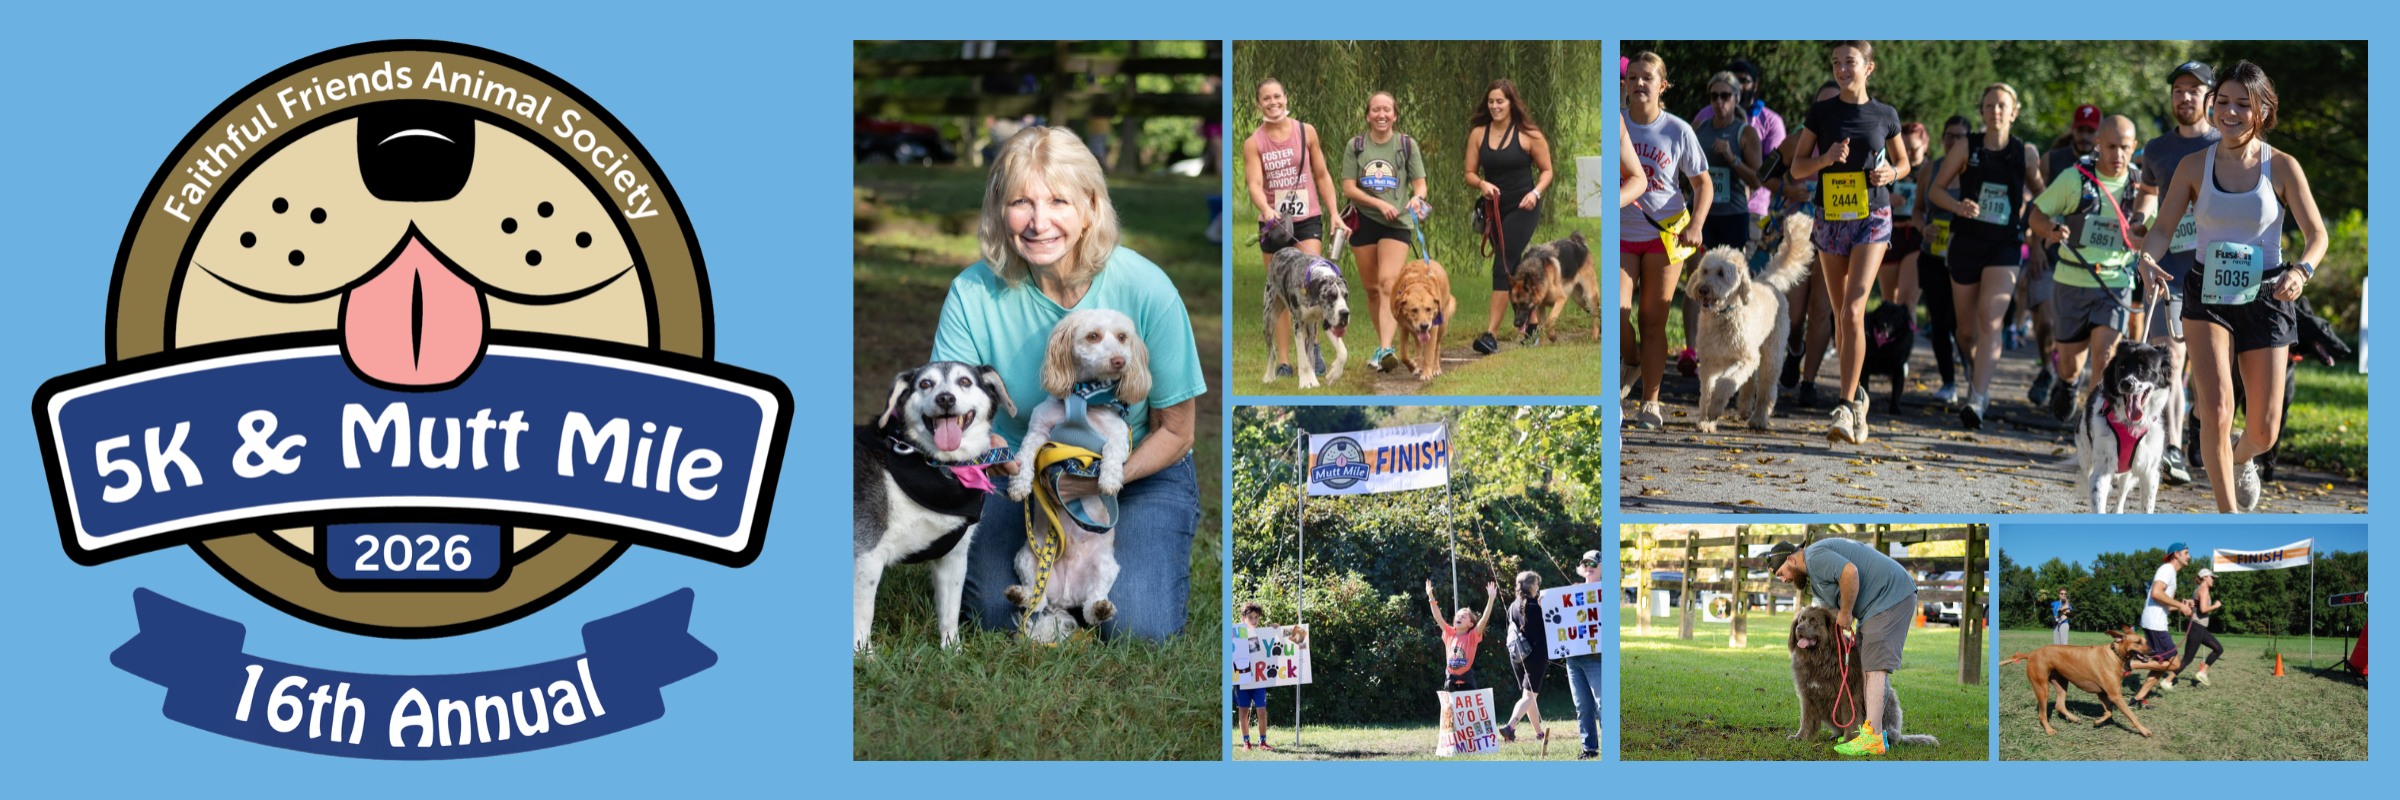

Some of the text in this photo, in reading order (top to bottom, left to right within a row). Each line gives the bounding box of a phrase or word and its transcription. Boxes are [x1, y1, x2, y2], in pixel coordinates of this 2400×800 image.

[164, 61, 658, 223] Faithful Friends Animal Society
[1262, 148, 1294, 162] FOSTER
[1264, 158, 1291, 171] ADOPT
[1266, 166, 1297, 179] RESCUE
[1832, 193, 1858, 207] 2444
[1981, 199, 2005, 214] 5119
[1280, 201, 1304, 216] 452
[2215, 249, 2252, 261] Fusion
[2214, 269, 2249, 287] 5035
[95, 402, 723, 503] 5K & Mutt Mile
[1375, 439, 1447, 475] FINISH
[1315, 465, 1365, 480] Mutt Mile
[355, 534, 472, 572] 2026
[2237, 550, 2283, 564] FINISH
[1577, 607, 1598, 623] ON
[1232, 626, 1248, 640] UR
[235, 657, 606, 748] 16th Annual
[1455, 693, 1484, 709] ARE
[1456, 706, 1489, 726] YOU
[1455, 733, 1496, 753] MUTT?
